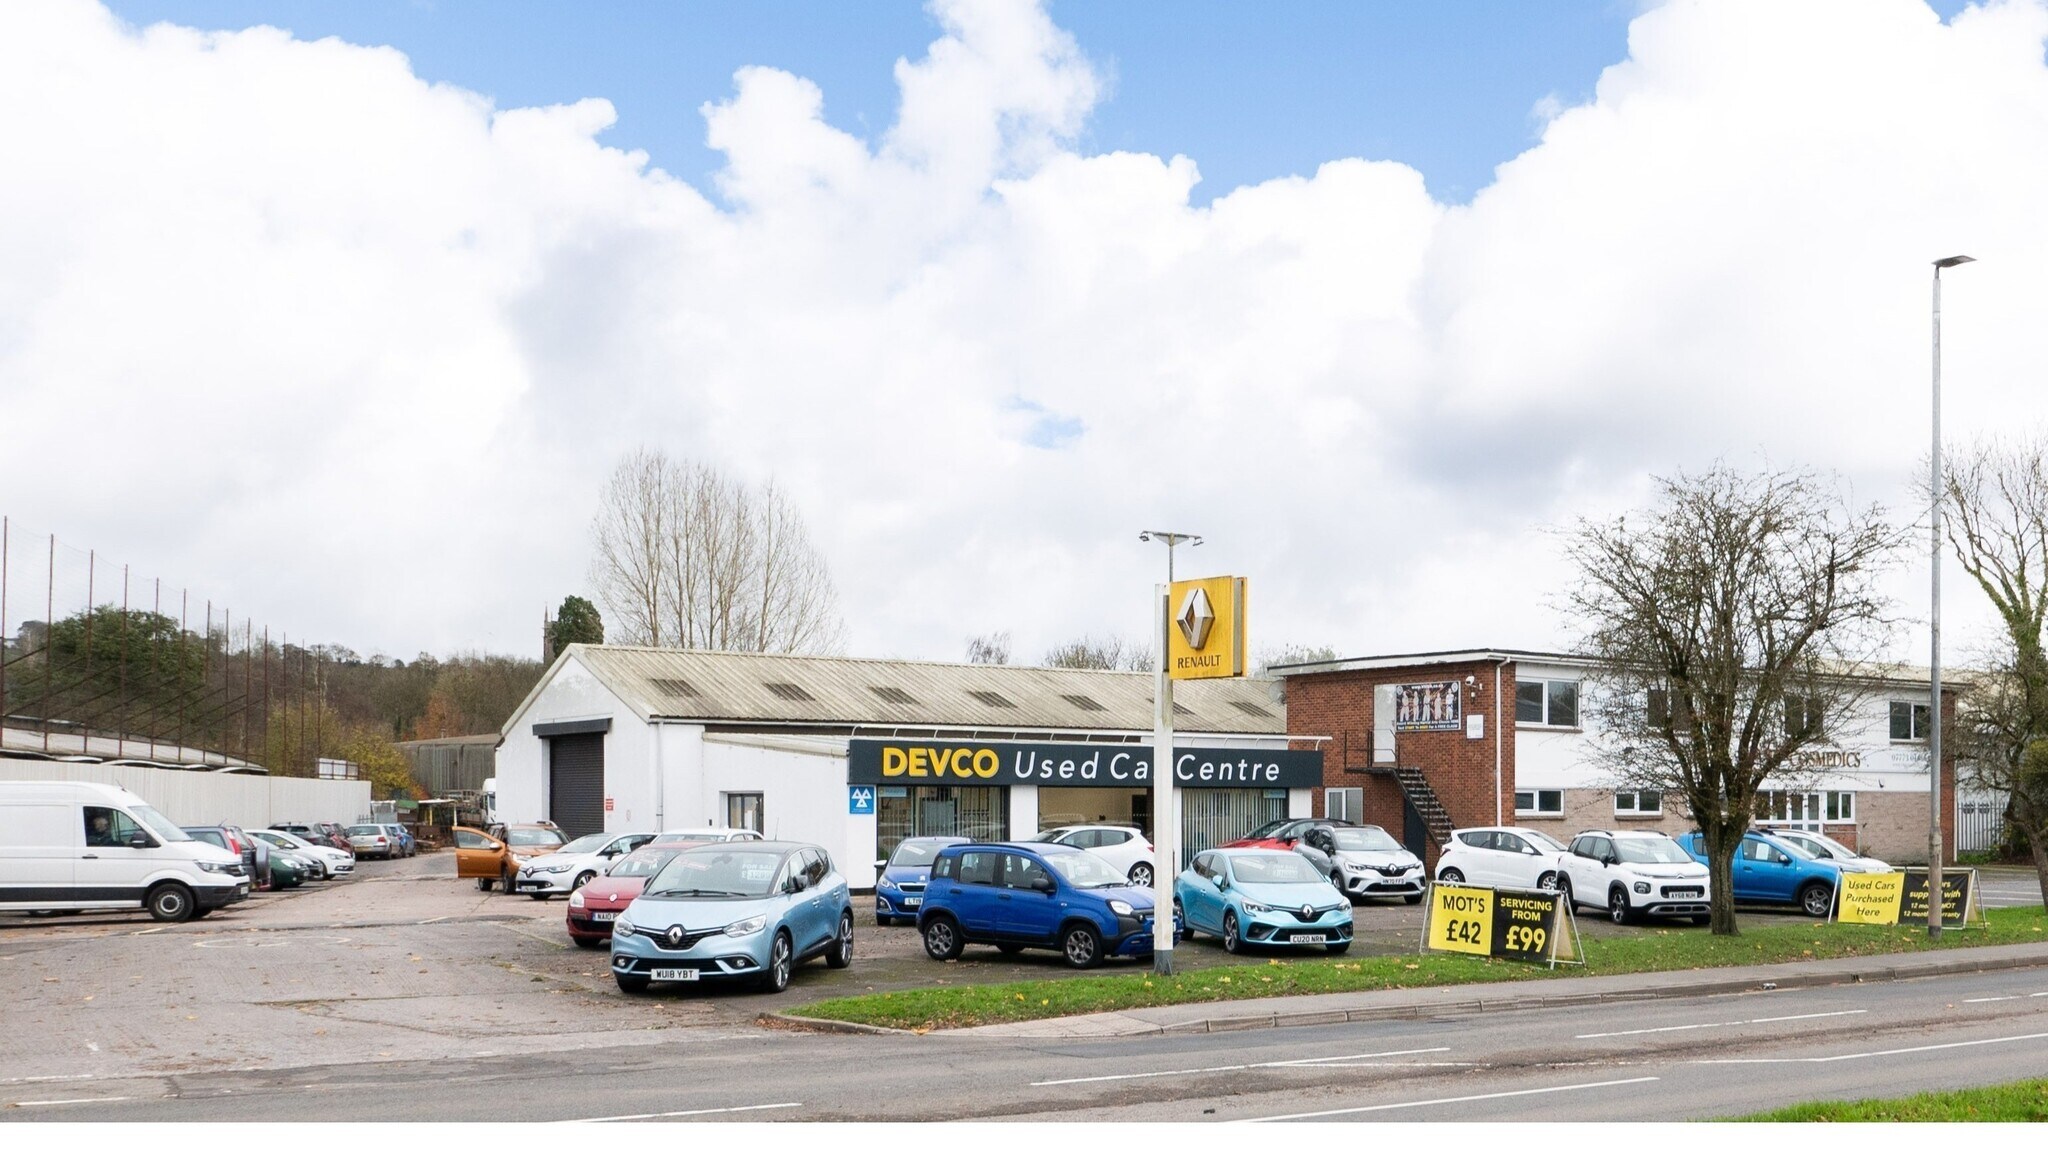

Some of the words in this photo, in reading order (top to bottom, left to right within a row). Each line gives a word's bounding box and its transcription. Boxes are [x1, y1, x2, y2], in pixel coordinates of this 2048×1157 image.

[1177, 654, 1221, 669] RENAULT
[882, 747, 999, 779] DEVCO
[1015, 751, 1099, 779] Used
[1110, 752, 1154, 781] Ca
[1176, 753, 1280, 781] Centre
[1848, 880, 1873, 890] Used
[1875, 880, 1895, 890] Cars
[1845, 893, 1895, 903] Purchased
[1944, 889, 1961, 898] with
[1443, 895, 1485, 913] MOT'S
[1500, 897, 1552, 912] SERVICING
[1512, 910, 1541, 921] FROM
[1856, 906, 1881, 916] Here
[1446, 919, 1481, 945] £42
[1505, 925, 1546, 953] £99
[656, 970, 675, 979] WU18
[677, 970, 694, 979] YBT
